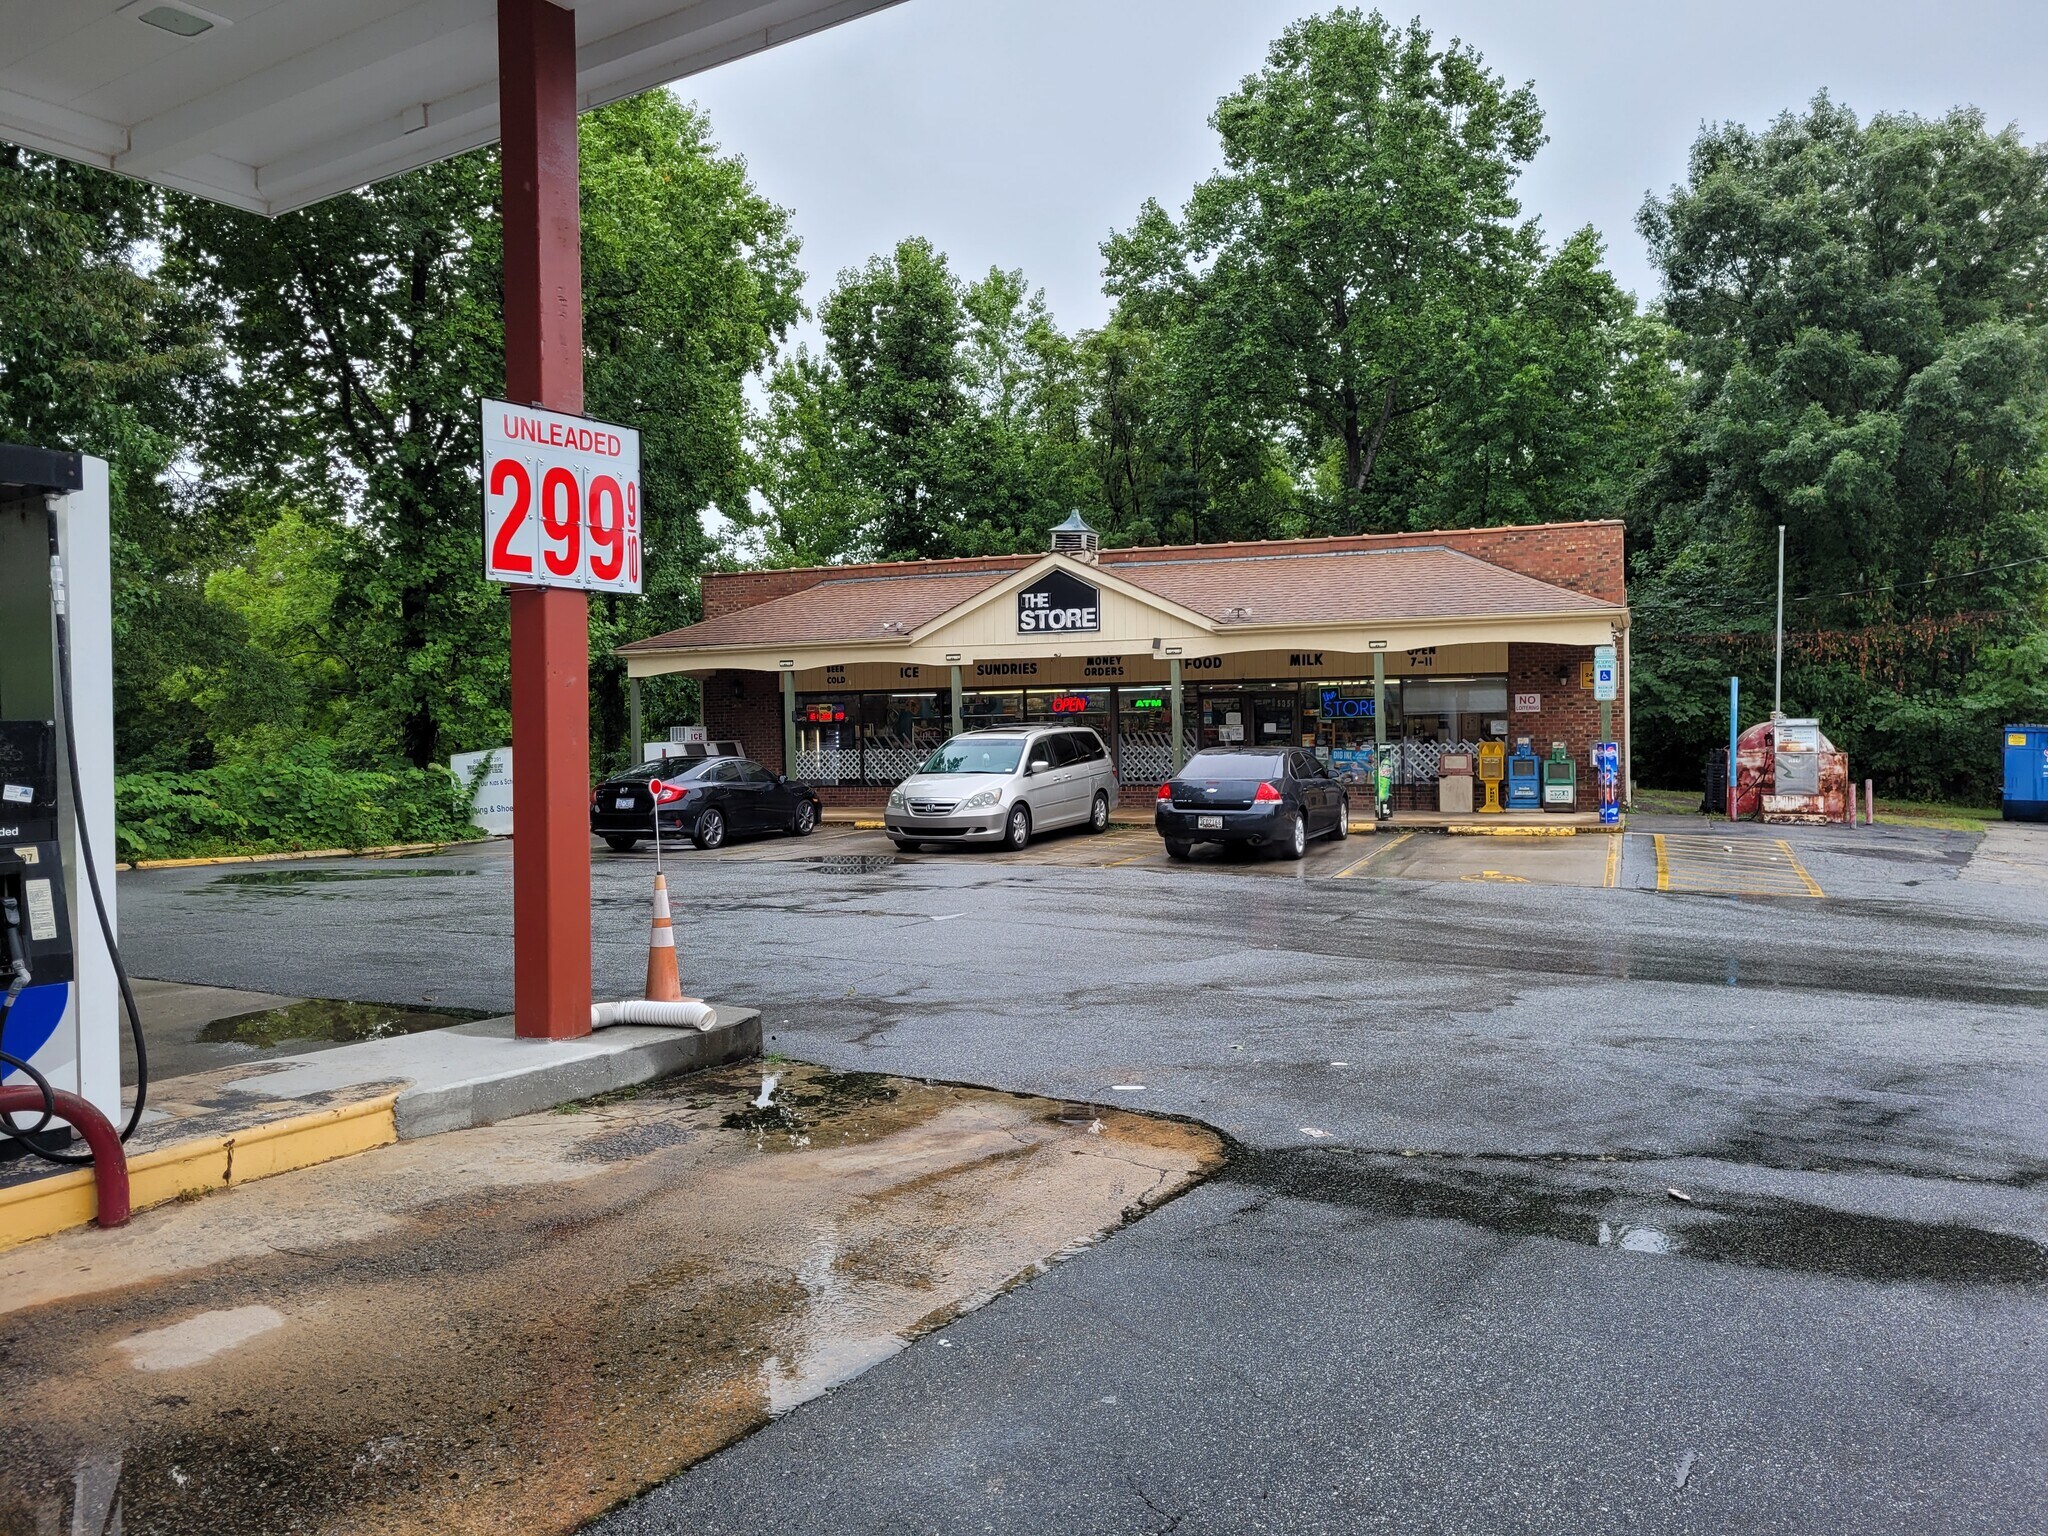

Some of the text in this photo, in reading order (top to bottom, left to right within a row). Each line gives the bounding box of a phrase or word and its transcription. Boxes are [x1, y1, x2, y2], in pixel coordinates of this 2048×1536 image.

[503, 414, 621, 457] UNLEADED
[490, 458, 625, 581] 299
[1021, 592, 1049, 608] THE
[1020, 607, 1097, 630] STORE
[1407, 646, 1436, 656] OPEN
[1086, 656, 1122, 666] MONEY
[1184, 656, 1222, 669] FOOD
[1289, 653, 1324, 666] MILK
[1410, 657, 1433, 667] 7-11
[826, 665, 845, 673] BEER
[900, 666, 919, 678] ICE
[976, 662, 1038, 676] SUNDRIES
[1084, 666, 1125, 677] ORDERS
[826, 676, 846, 684] COLD
[1322, 690, 1336, 701] the
[1519, 696, 1536, 705] NO
[1053, 696, 1087, 712] OPEN
[1135, 699, 1162, 708] ATM
[1323, 700, 1376, 717] STORE
[690, 733, 703, 741] ICE
